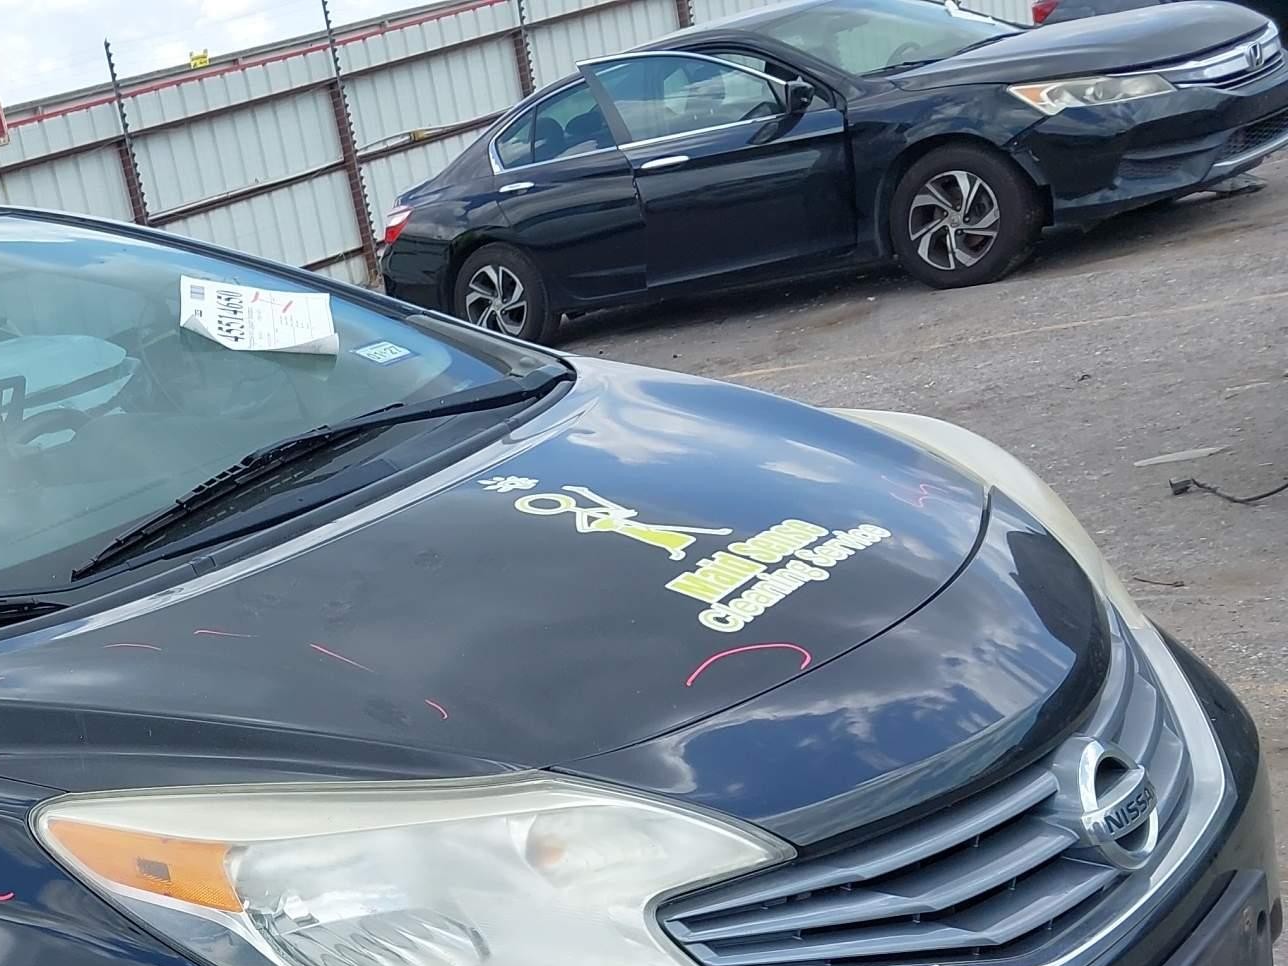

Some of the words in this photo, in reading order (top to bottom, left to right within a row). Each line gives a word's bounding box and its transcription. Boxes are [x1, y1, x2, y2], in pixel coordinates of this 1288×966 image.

[215, 290, 245, 342] 45514650
[665, 550, 768, 603] Maid
[727, 519, 830, 564] Sense
[698, 559, 830, 633] Cleaning
[794, 524, 892, 567] Service
[1103, 786, 1157, 834] NISSA
